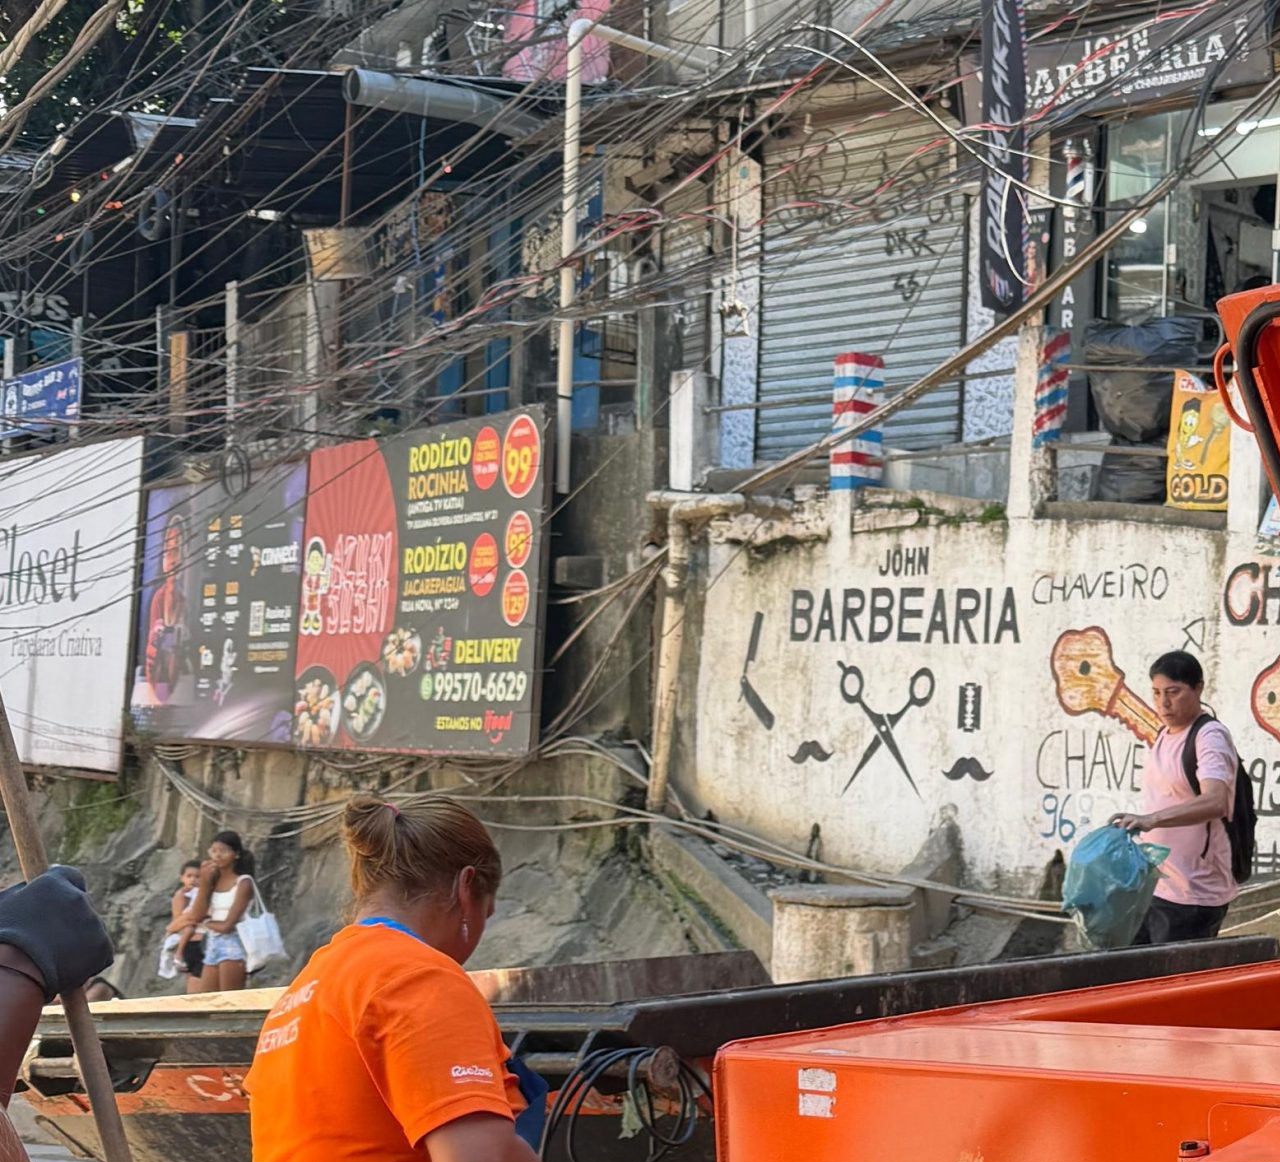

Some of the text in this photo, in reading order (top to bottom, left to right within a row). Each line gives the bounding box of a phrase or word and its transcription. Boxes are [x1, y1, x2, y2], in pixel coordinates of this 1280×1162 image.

[409, 433, 472, 473] RODÍZIO
[507, 446, 532, 485] 99
[408, 469, 469, 500] ROCINHA
[1170, 473, 1229, 504] GOLD
[404, 536, 467, 574] RODÍZIO
[879, 546, 930, 577] JOHN
[790, 587, 1021, 644] BARBEARIA
[454, 637, 522, 665] DELIVERY
[434, 671, 527, 702] 99570-6629
[435, 716, 470, 731] ESTAMOS
[470, 716, 482, 731] NO
[1036, 729, 1145, 792] CHAVE
